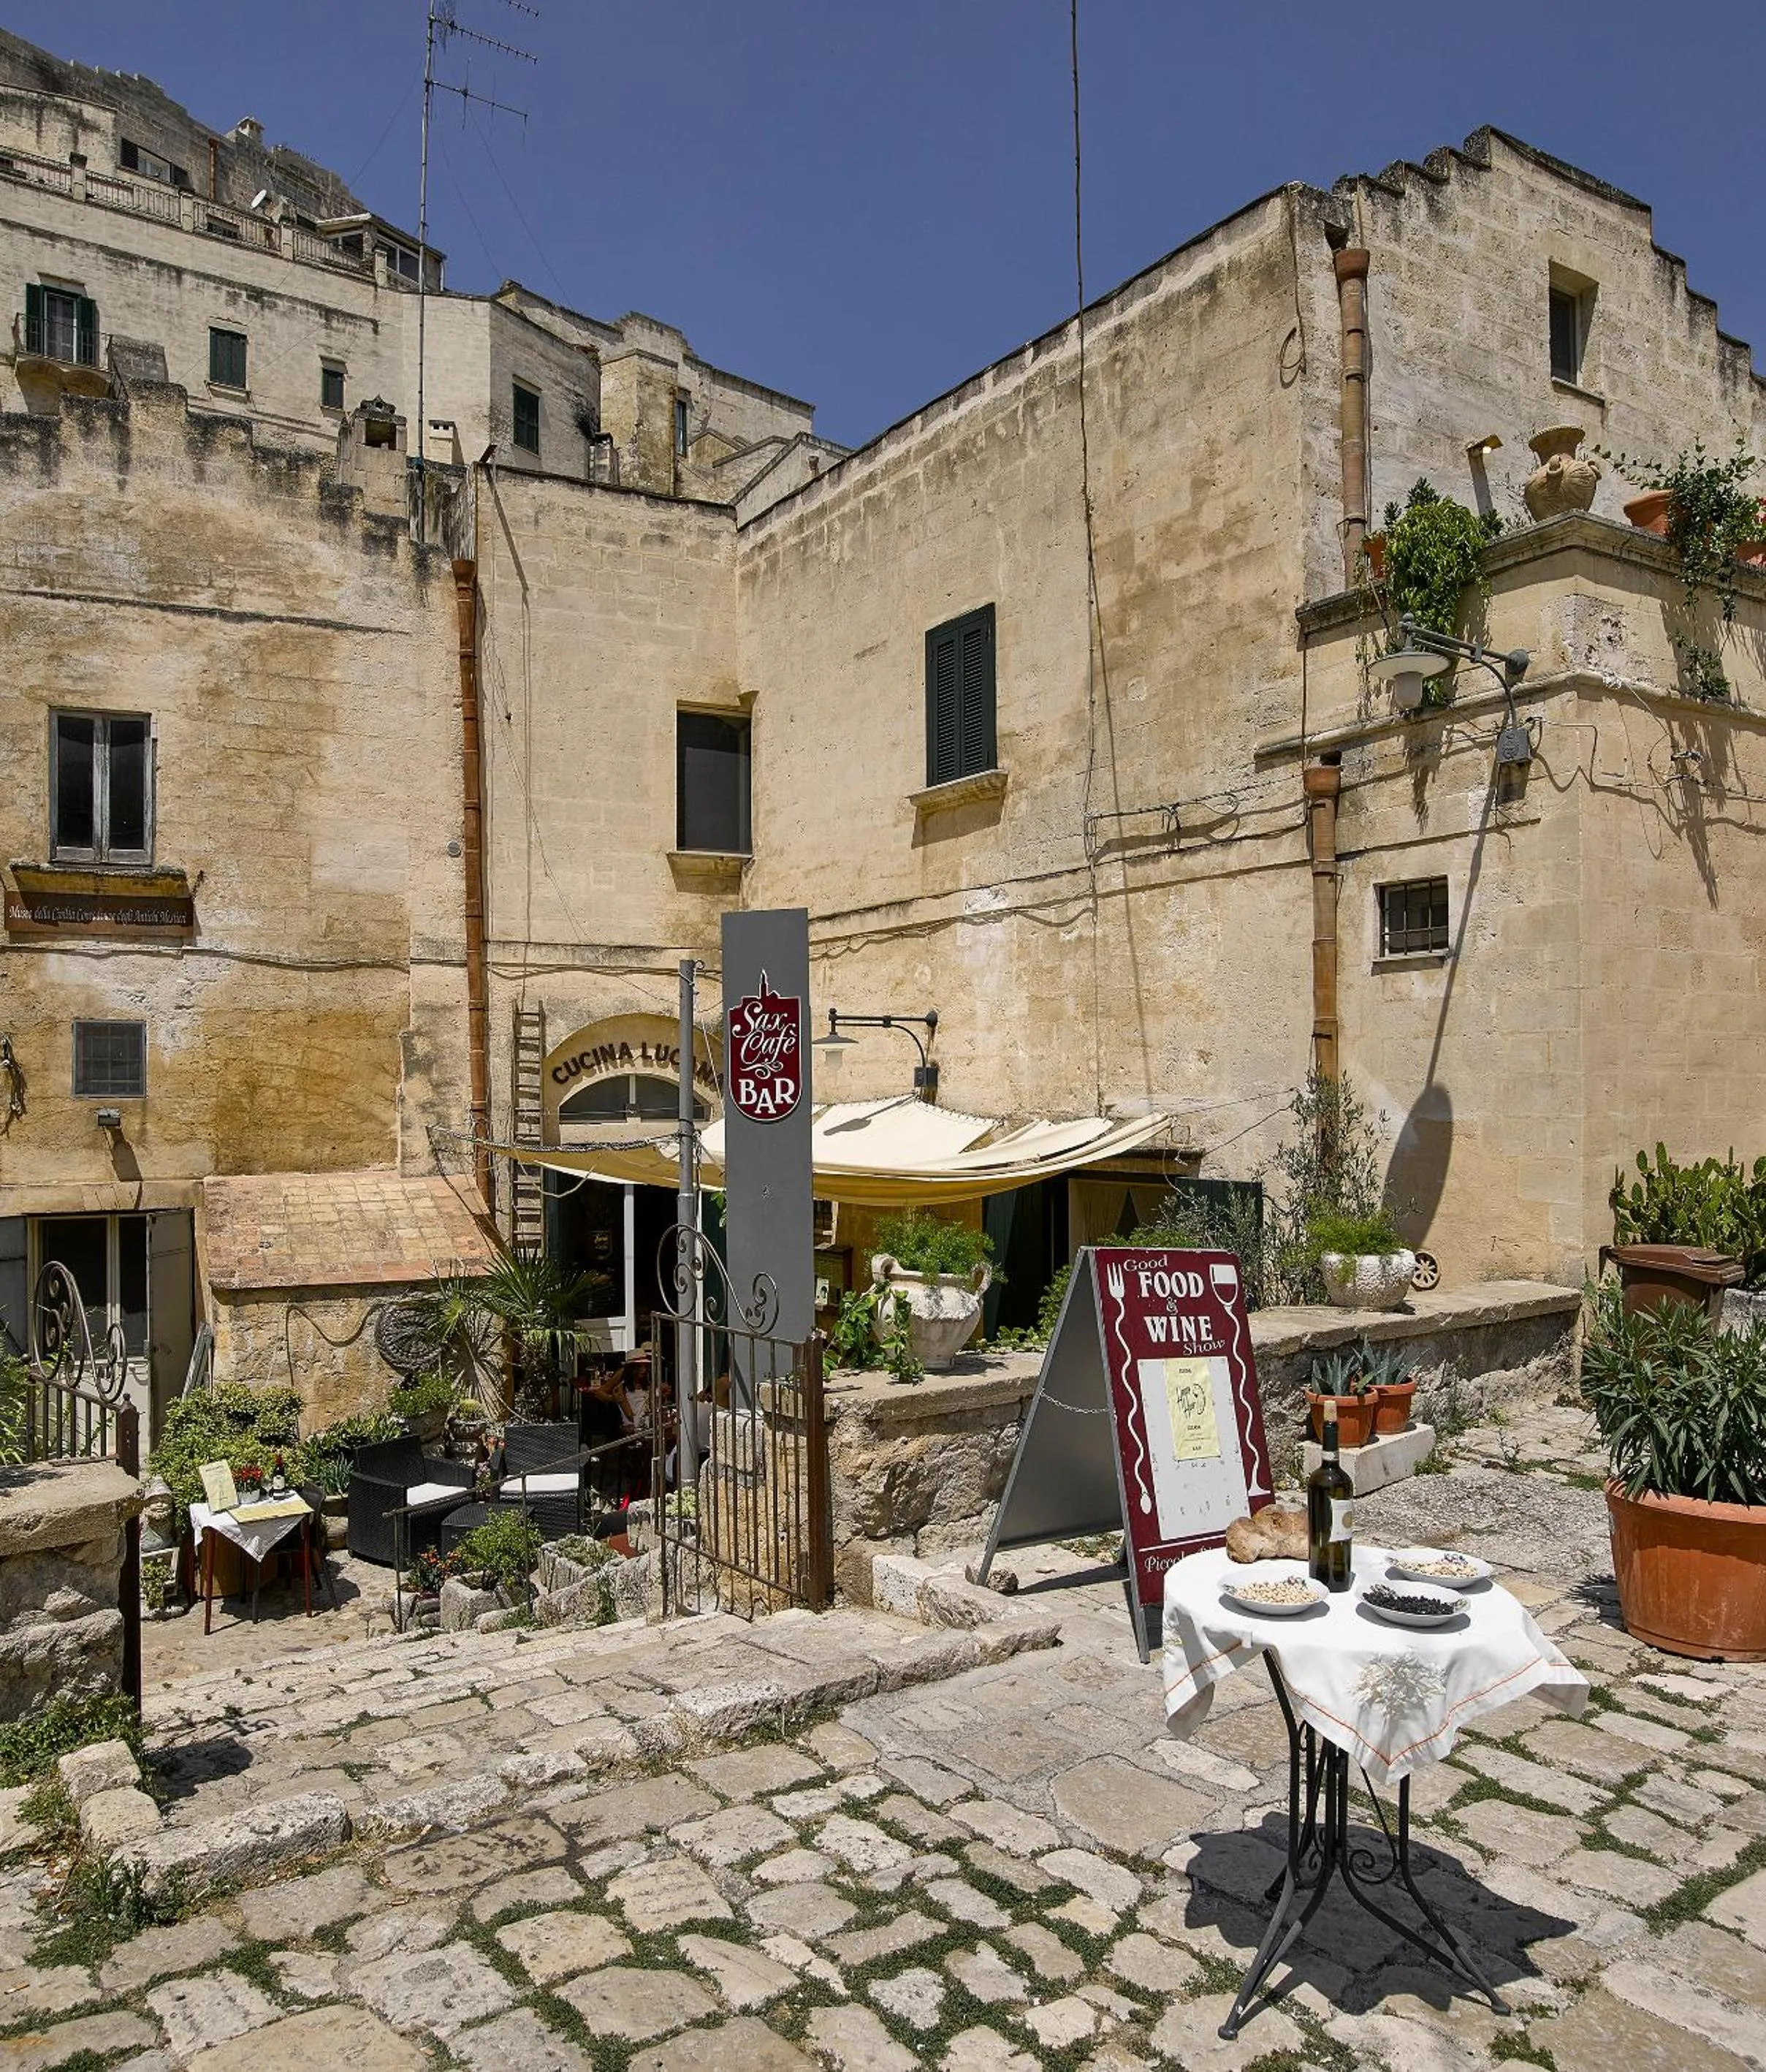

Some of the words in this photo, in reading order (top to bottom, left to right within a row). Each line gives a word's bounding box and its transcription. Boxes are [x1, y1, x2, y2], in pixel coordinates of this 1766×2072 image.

[732, 1001, 788, 1038] Sax
[740, 1023, 797, 1065] Cafè
[552, 1042, 633, 1085] CUCINA
[641, 1041, 724, 1090] LUCNA
[738, 1077, 794, 1115] BAR
[1123, 1254, 1168, 1272] Good
[1138, 1271, 1204, 1298] FOOD
[1165, 1297, 1179, 1316] &
[1143, 1316, 1213, 1343] WINE
[1183, 1339, 1225, 1356] Show
